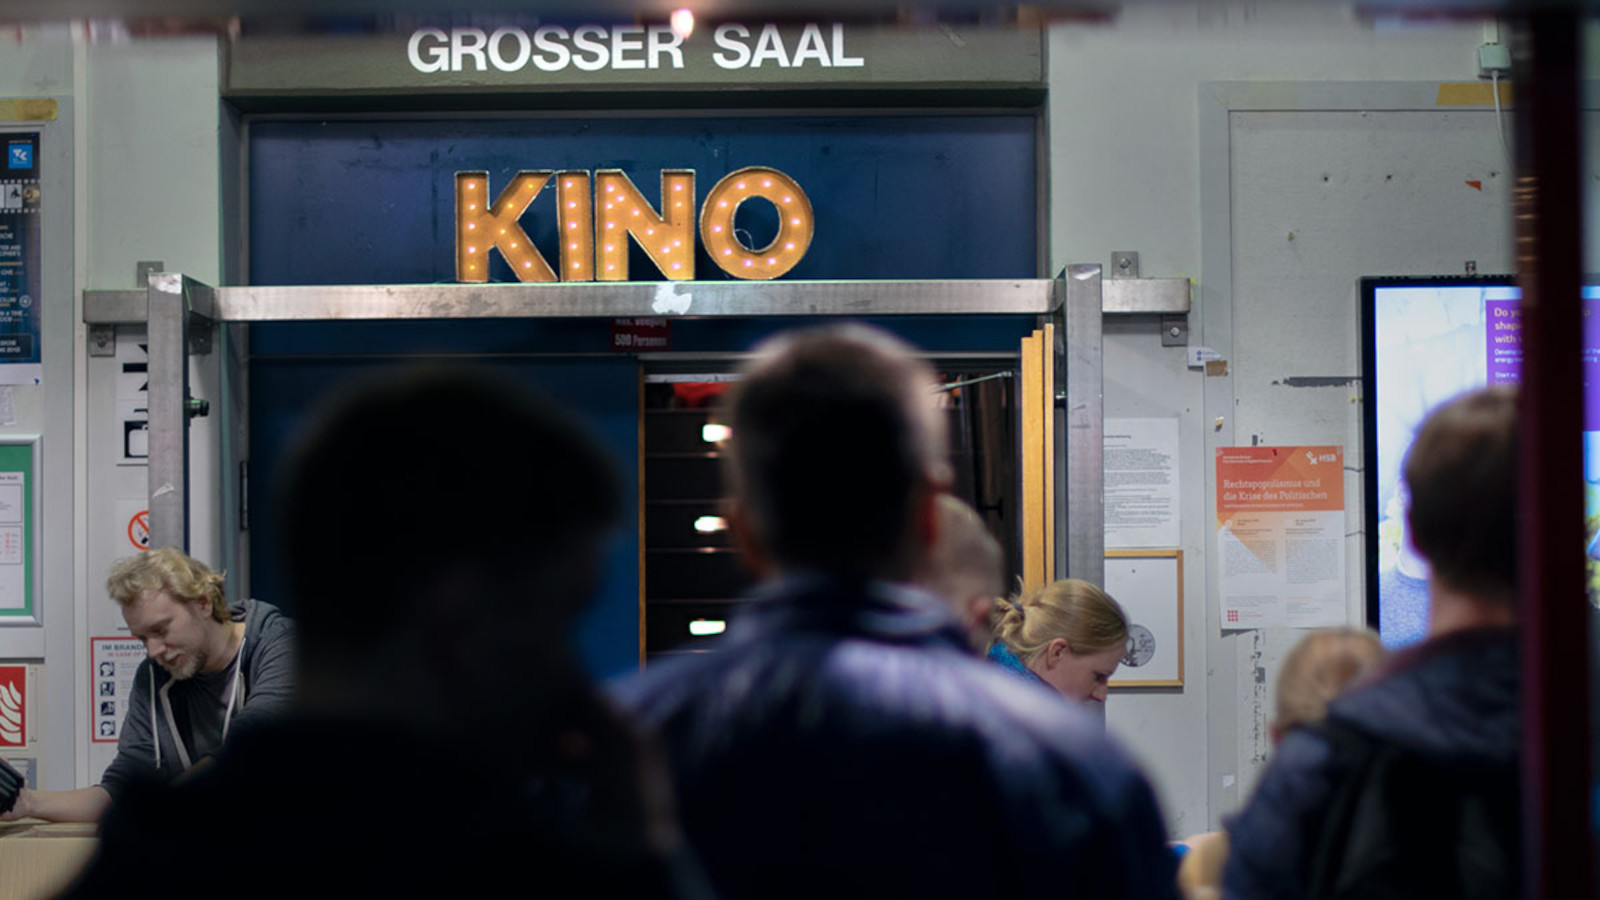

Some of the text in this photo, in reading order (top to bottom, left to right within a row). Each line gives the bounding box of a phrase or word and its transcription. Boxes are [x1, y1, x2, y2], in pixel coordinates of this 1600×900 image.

[407, 23, 865, 73] GROSSER SAAL
[454, 166, 815, 283] KINO
[1494, 307, 1508, 317] Do
[615, 334, 632, 346] 500
[1319, 453, 1337, 462] HSB
[1303, 478, 1321, 488] und
[1223, 490, 1328, 501] die Krise des Politischen
